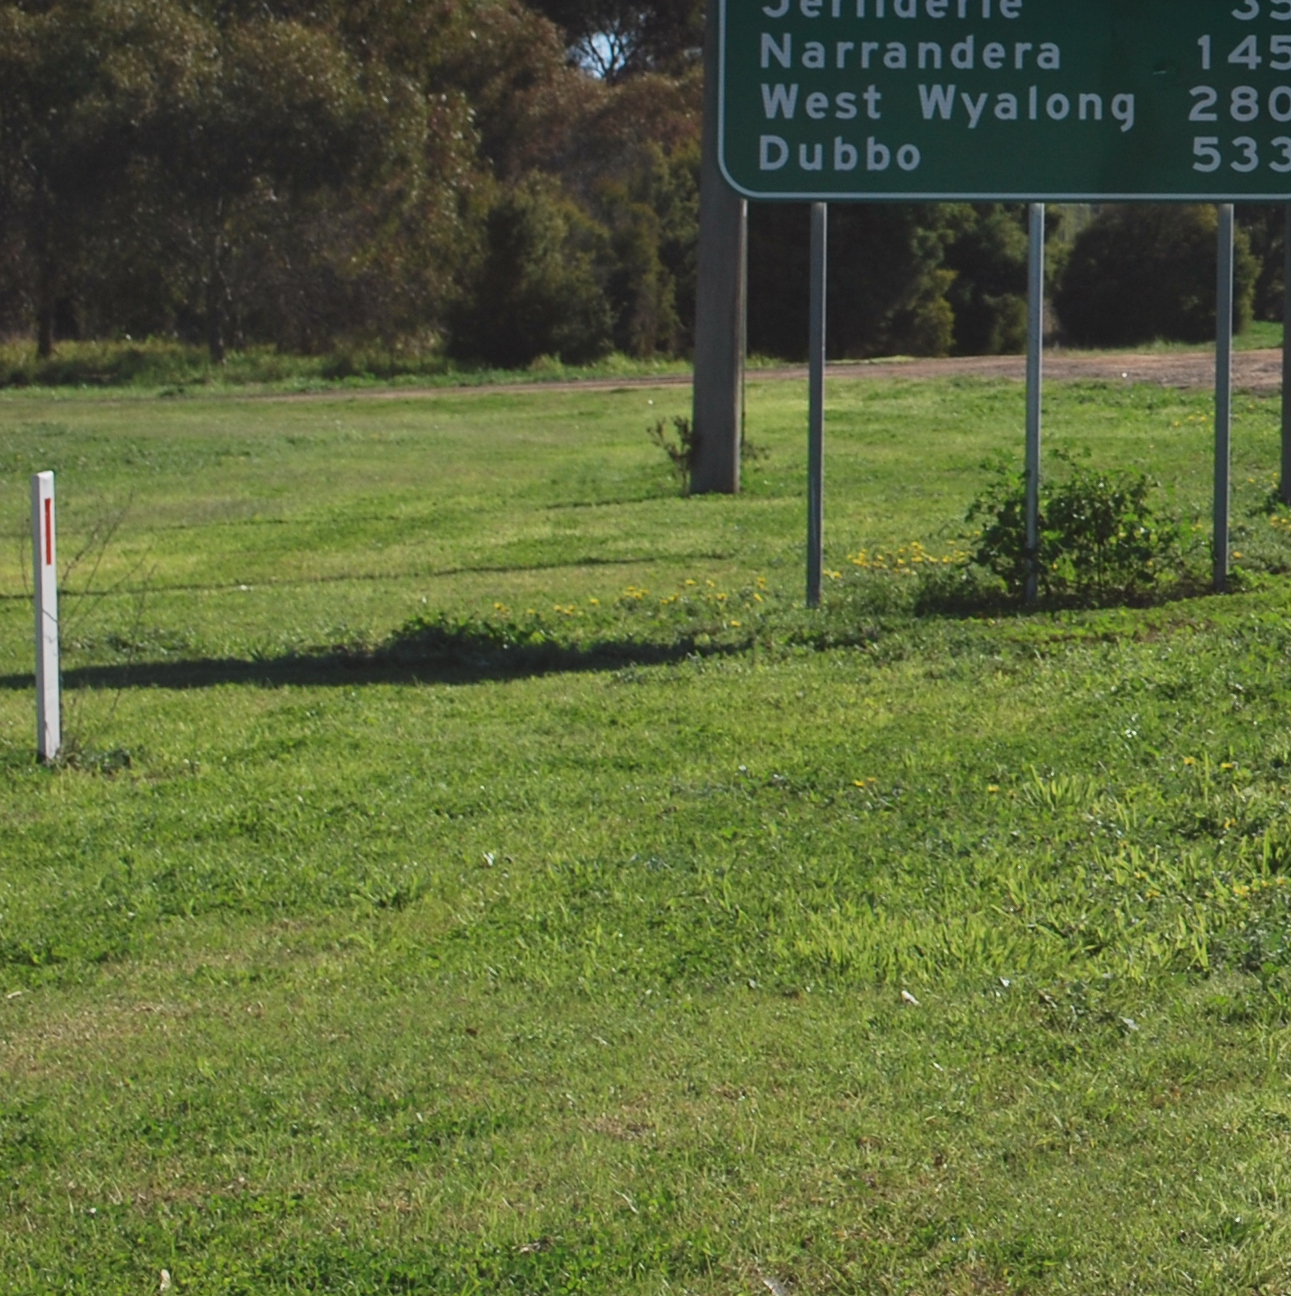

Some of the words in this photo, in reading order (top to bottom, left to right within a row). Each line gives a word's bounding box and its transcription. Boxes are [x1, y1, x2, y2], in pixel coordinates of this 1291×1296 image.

[760, 32, 1061, 70] Narrandera
[760, 83, 882, 120] West
[918, 83, 1135, 132] Wyalong
[759, 134, 921, 171] Dubbo
